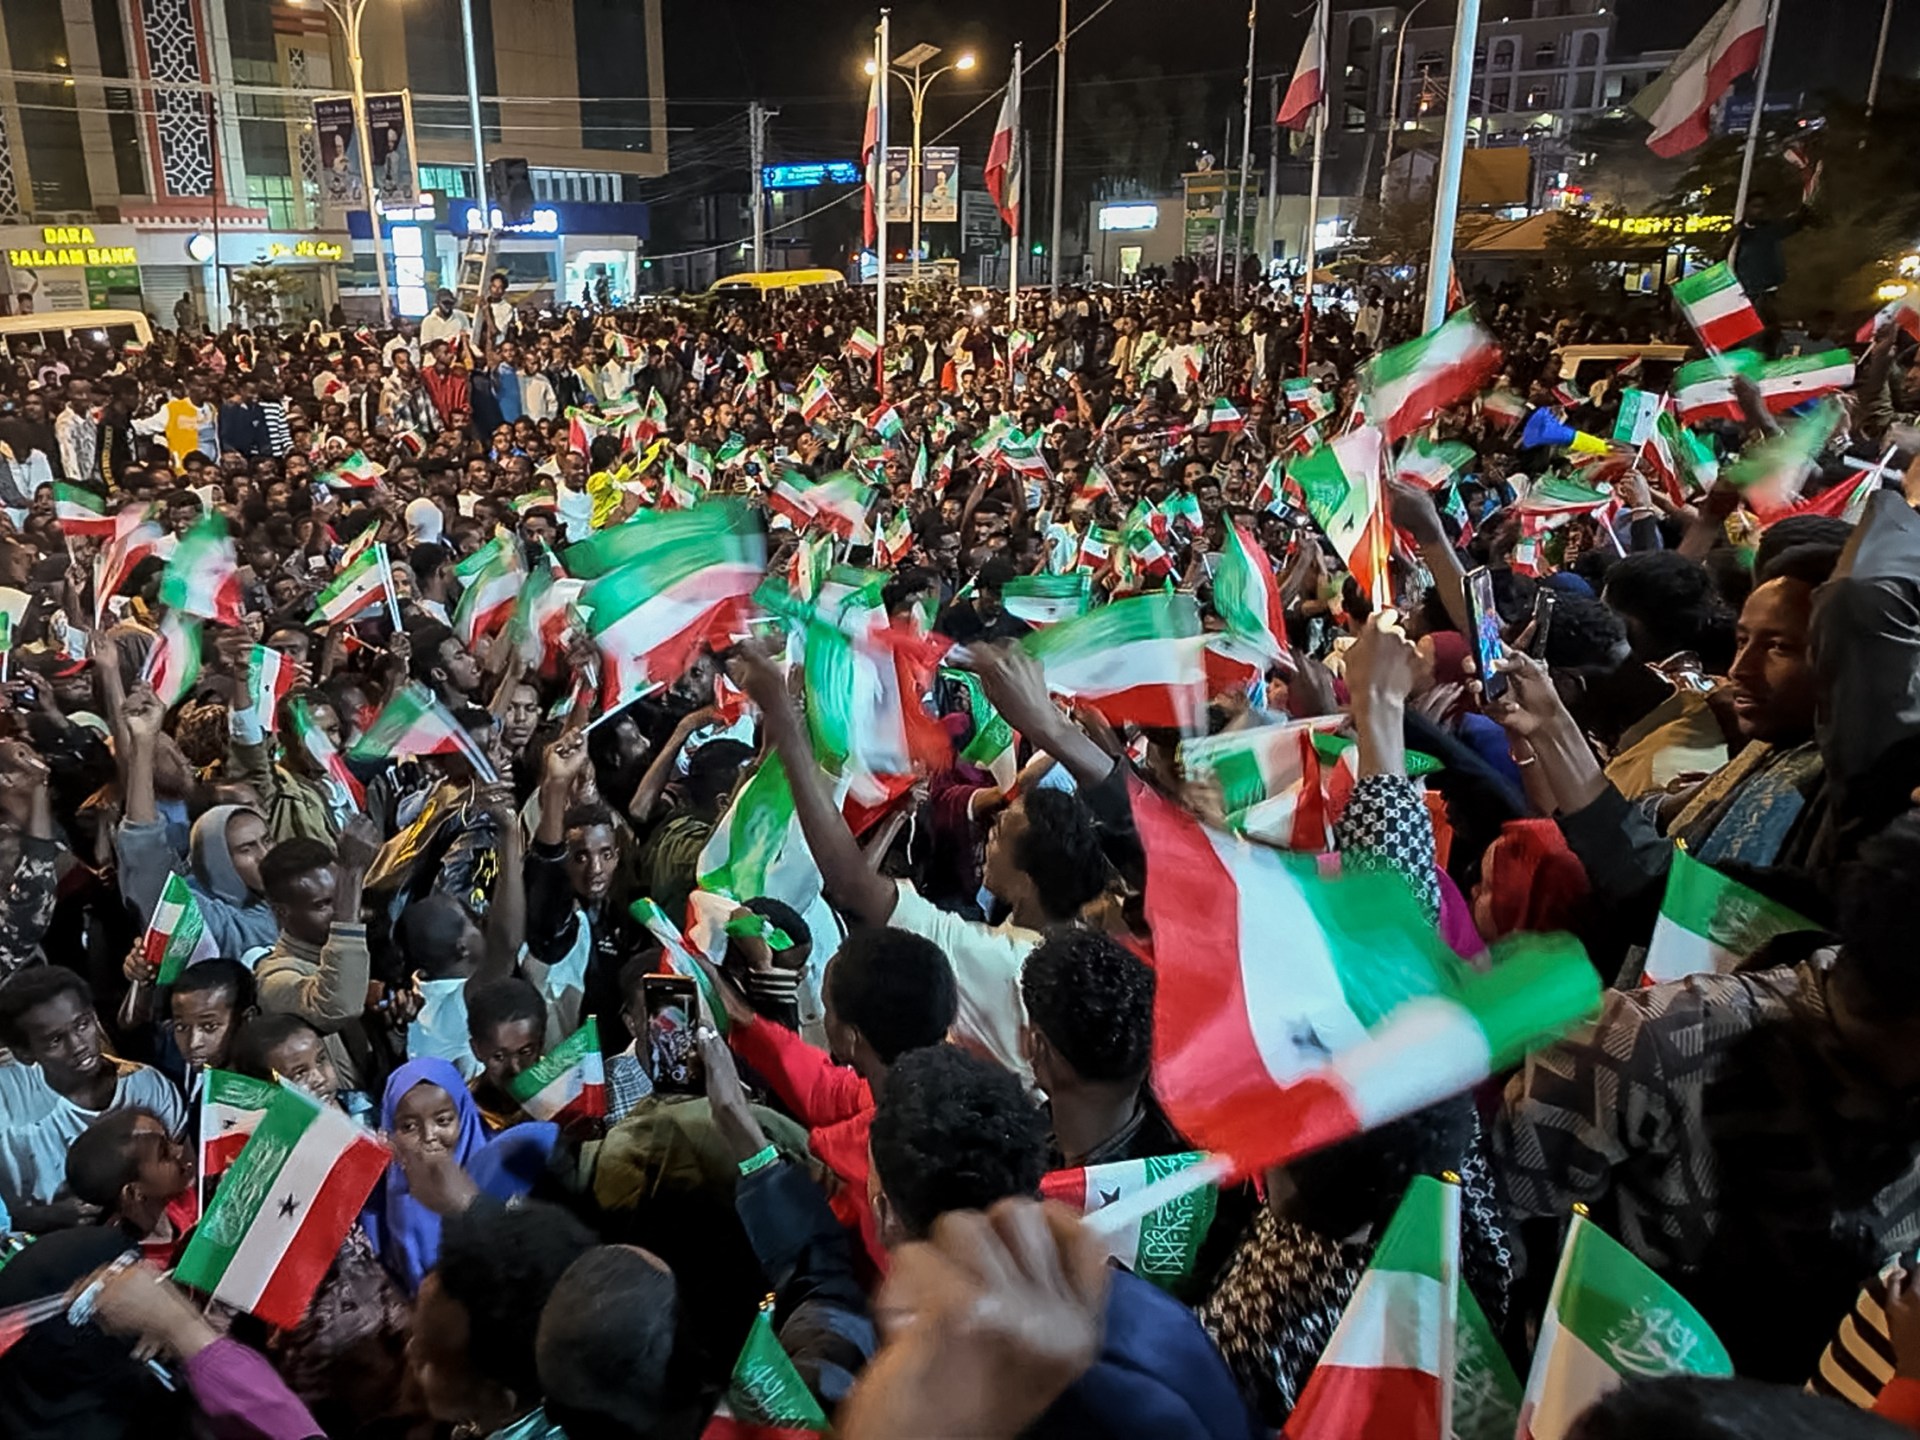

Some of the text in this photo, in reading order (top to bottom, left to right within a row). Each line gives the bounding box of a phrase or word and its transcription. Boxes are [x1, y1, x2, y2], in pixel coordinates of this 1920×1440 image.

[44, 228, 95, 244] DARA
[10, 247, 137, 266] SALAAM BANK
